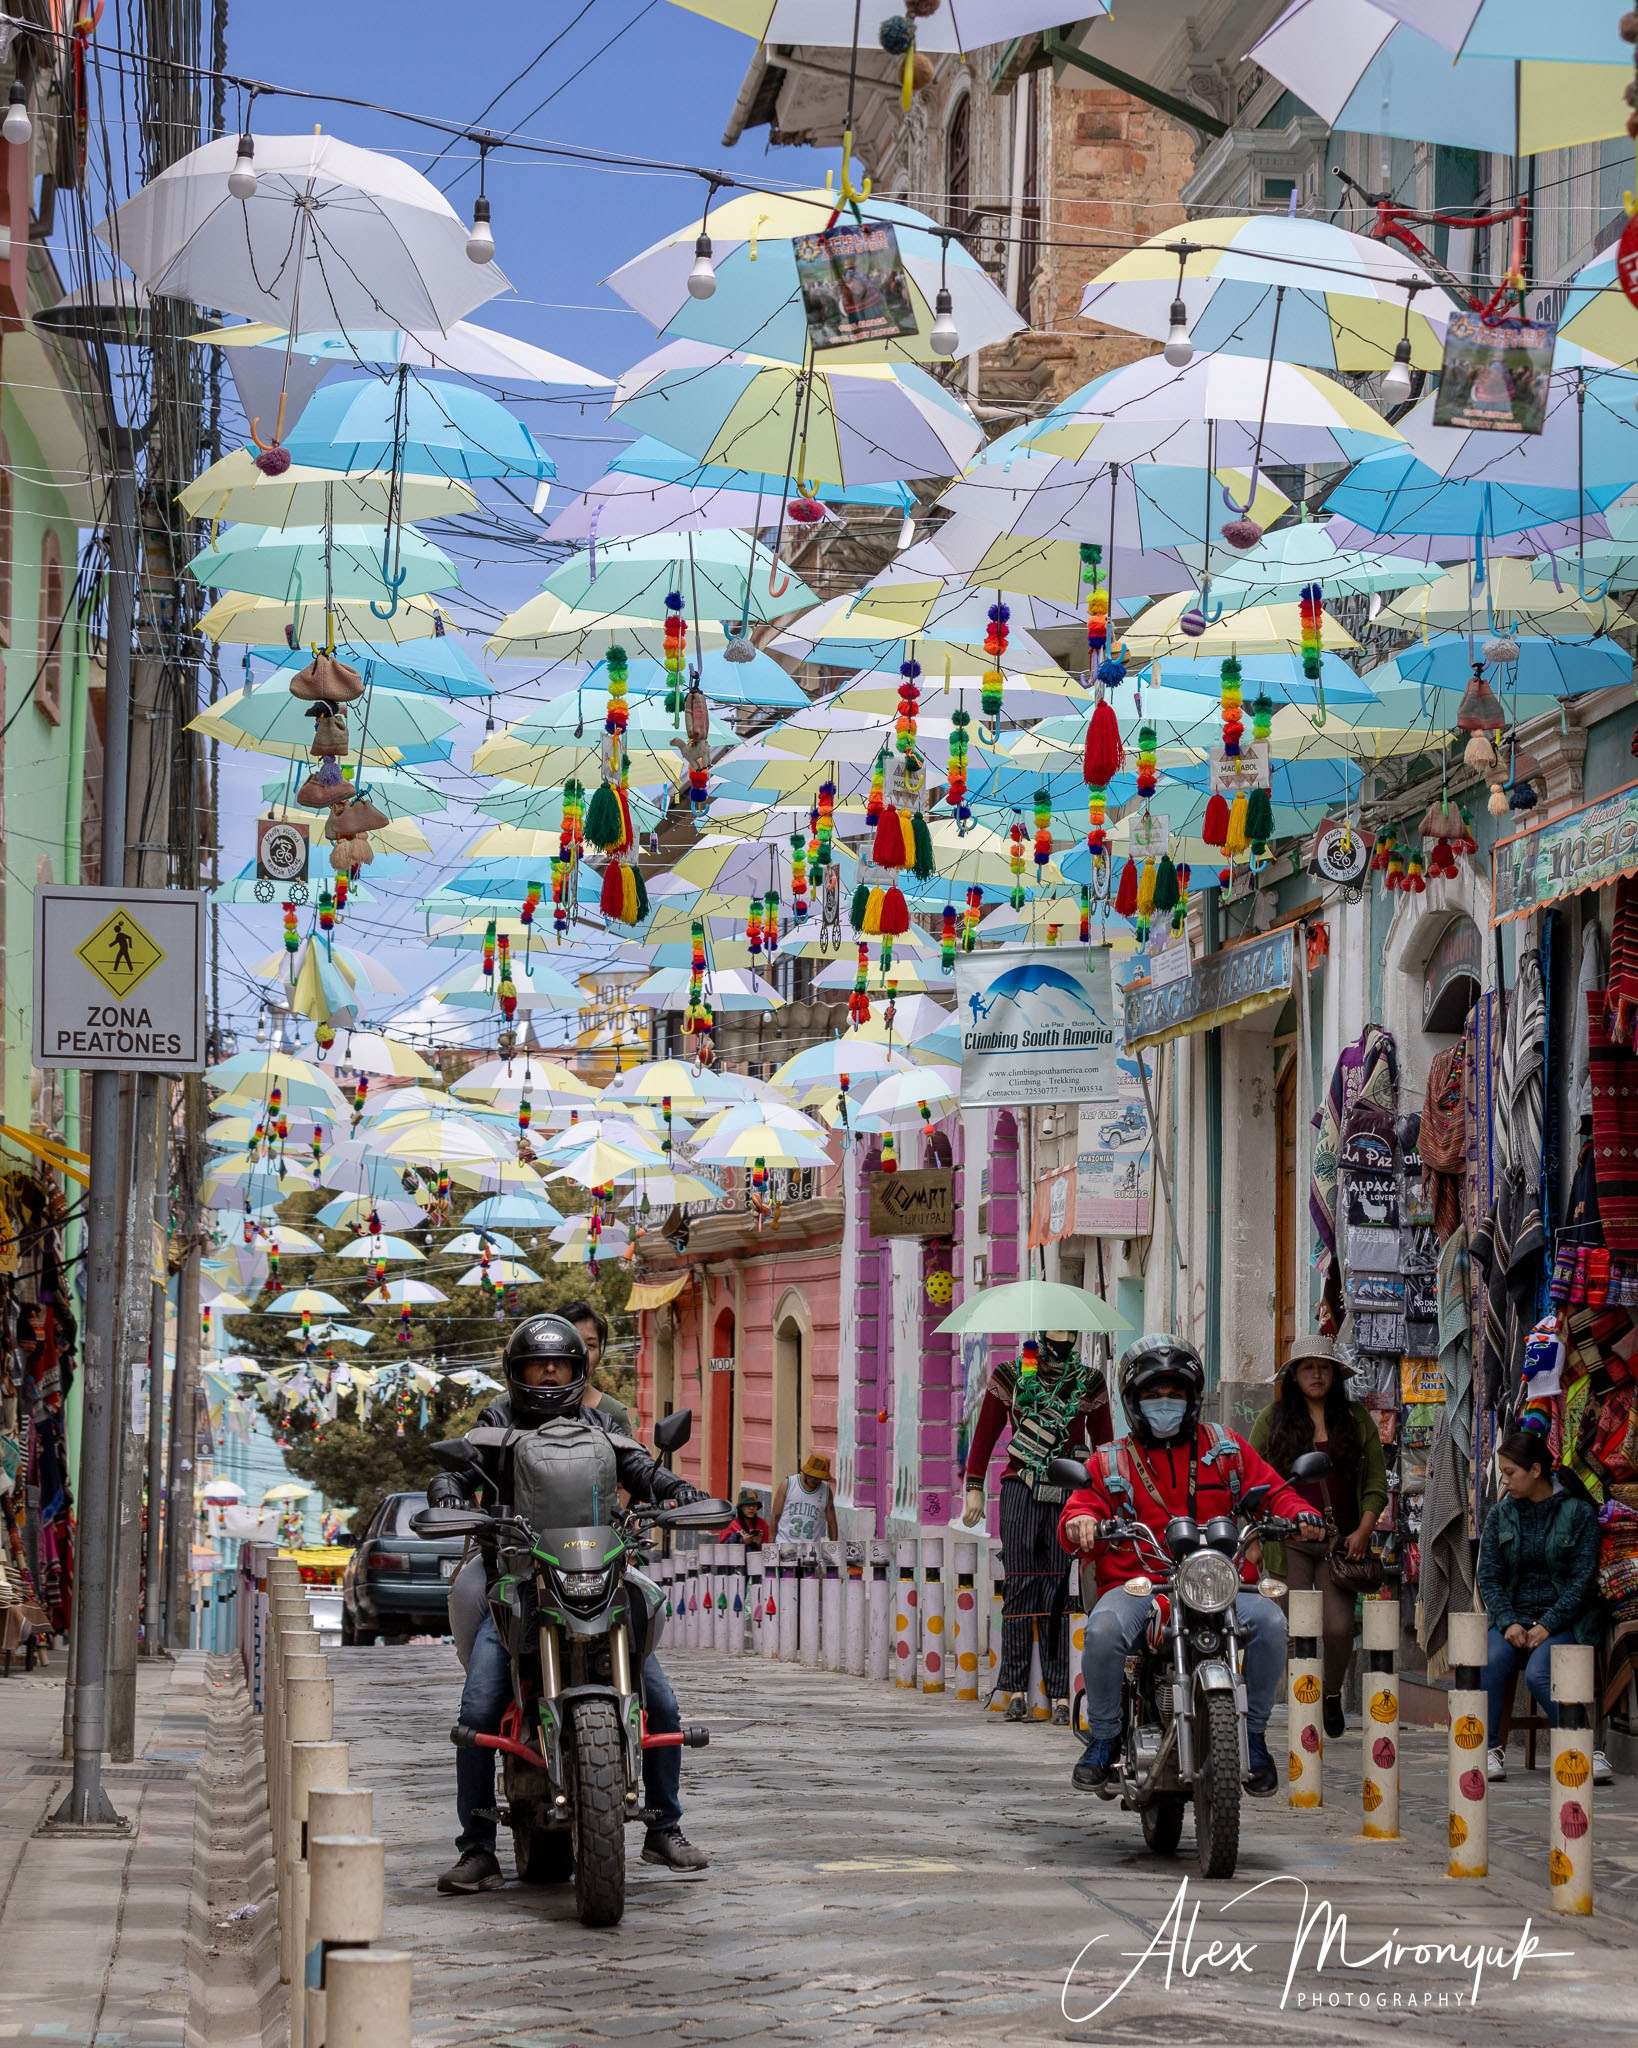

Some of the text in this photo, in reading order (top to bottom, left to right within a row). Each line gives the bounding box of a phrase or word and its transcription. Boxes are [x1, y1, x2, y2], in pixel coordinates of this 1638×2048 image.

[1220, 763, 1258, 773] MACABOL
[595, 985, 637, 1005] HOTE
[87, 1007, 152, 1028] ZONA
[579, 1010, 649, 1031] NUEVO SO
[58, 1031, 181, 1055] PEATONES
[965, 1027, 1113, 1050] Climbing South America
[988, 1067, 1099, 1077] www.climbingsouthamerica.com
[1009, 1078, 1041, 1087] Climbing
[1049, 1077, 1080, 1085] Trekking
[1117, 1076, 1152, 1085] REKKIG
[1025, 1087, 1058, 1095] 72530777
[1070, 1085, 1103, 1093] 71903534
[1080, 1110, 1118, 1120] SALT FLATS
[1078, 1155, 1114, 1163] AMAZONIAN
[1404, 1152, 1423, 1165] alp
[1349, 1181, 1397, 1192] ALPACA
[1114, 1190, 1148, 1199] BIKING
[1421, 1371, 1443, 1380] INCA
[1420, 1382, 1445, 1391] KOLA
[789, 1502, 820, 1520] CELTICS
[789, 1518, 814, 1539] 34
